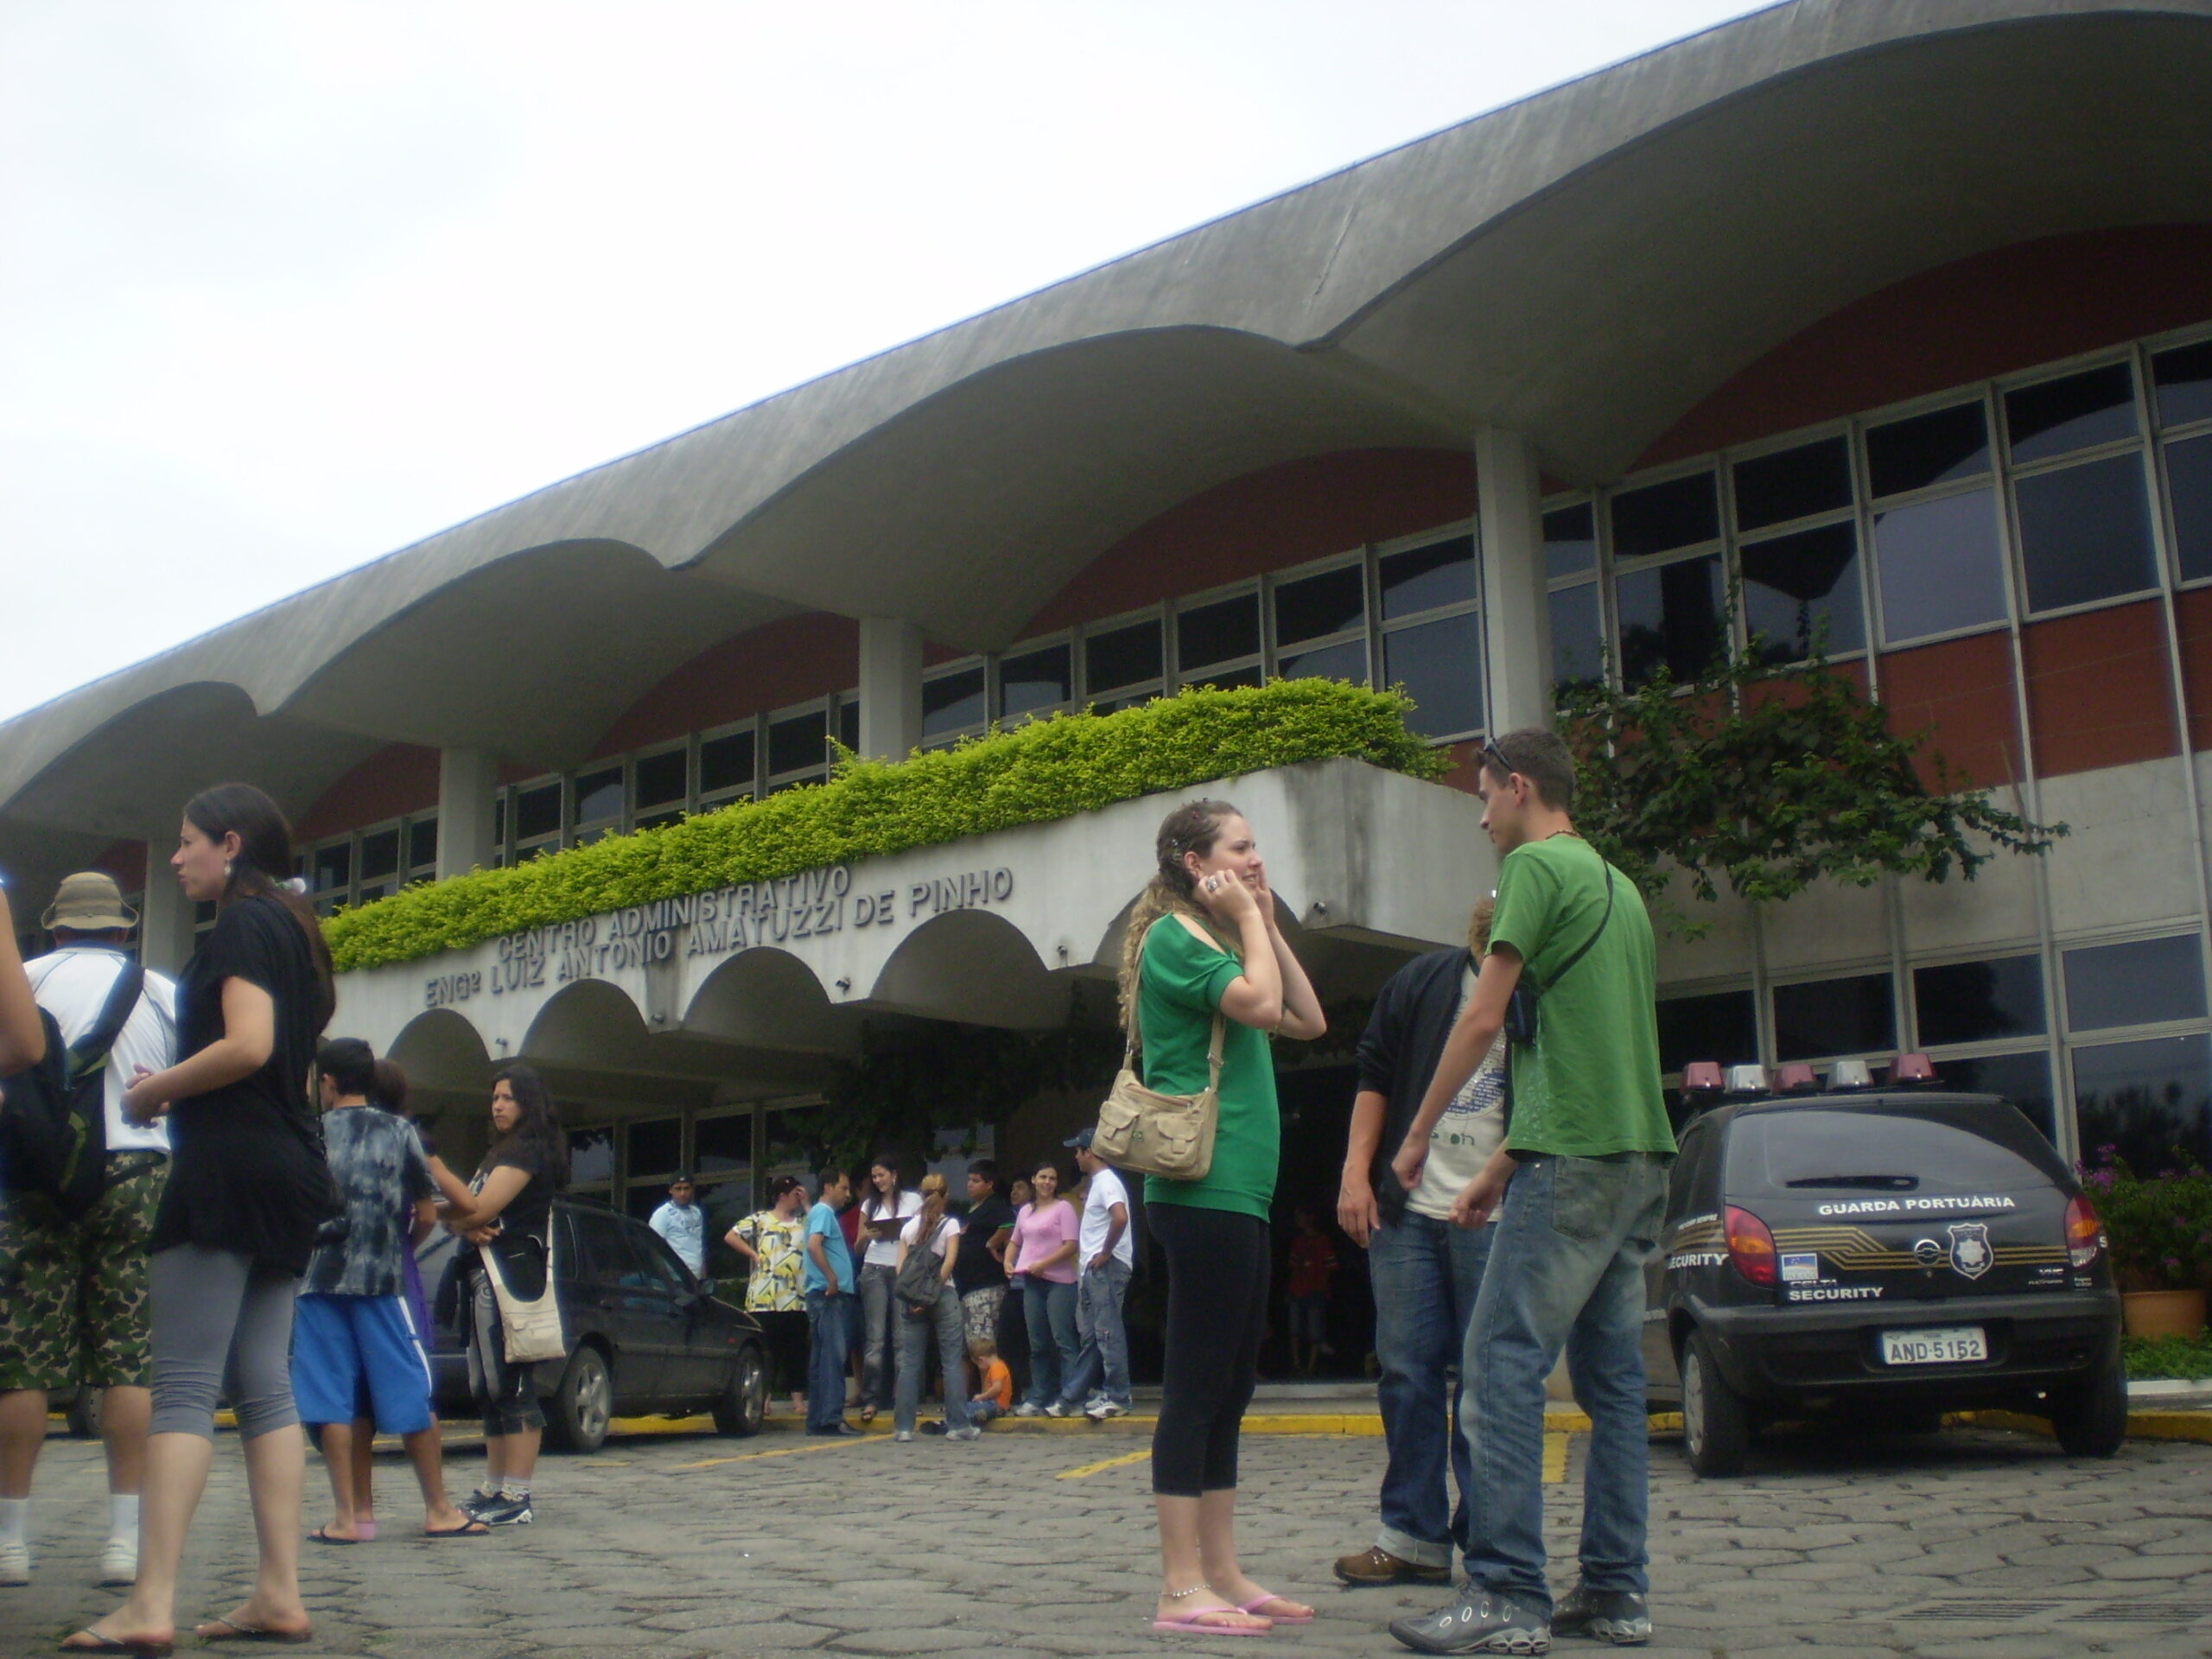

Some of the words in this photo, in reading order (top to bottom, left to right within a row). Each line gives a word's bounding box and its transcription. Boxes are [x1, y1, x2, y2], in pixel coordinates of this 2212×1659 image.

[490, 957, 545, 995] LUIZ
[556, 931, 672, 982] ANTONIO
[687, 896, 844, 957] AMATUZZI
[853, 888, 896, 929] DE
[908, 867, 1014, 918] PINHO
[497, 918, 597, 963] CENTRO
[608, 865, 851, 941] ADMINISTRATIVO
[1818, 1200, 1900, 1216] GUARDA
[1905, 1196, 2015, 1210] PORTUÁRIA
[1789, 1287, 1884, 1300] SECURITY
